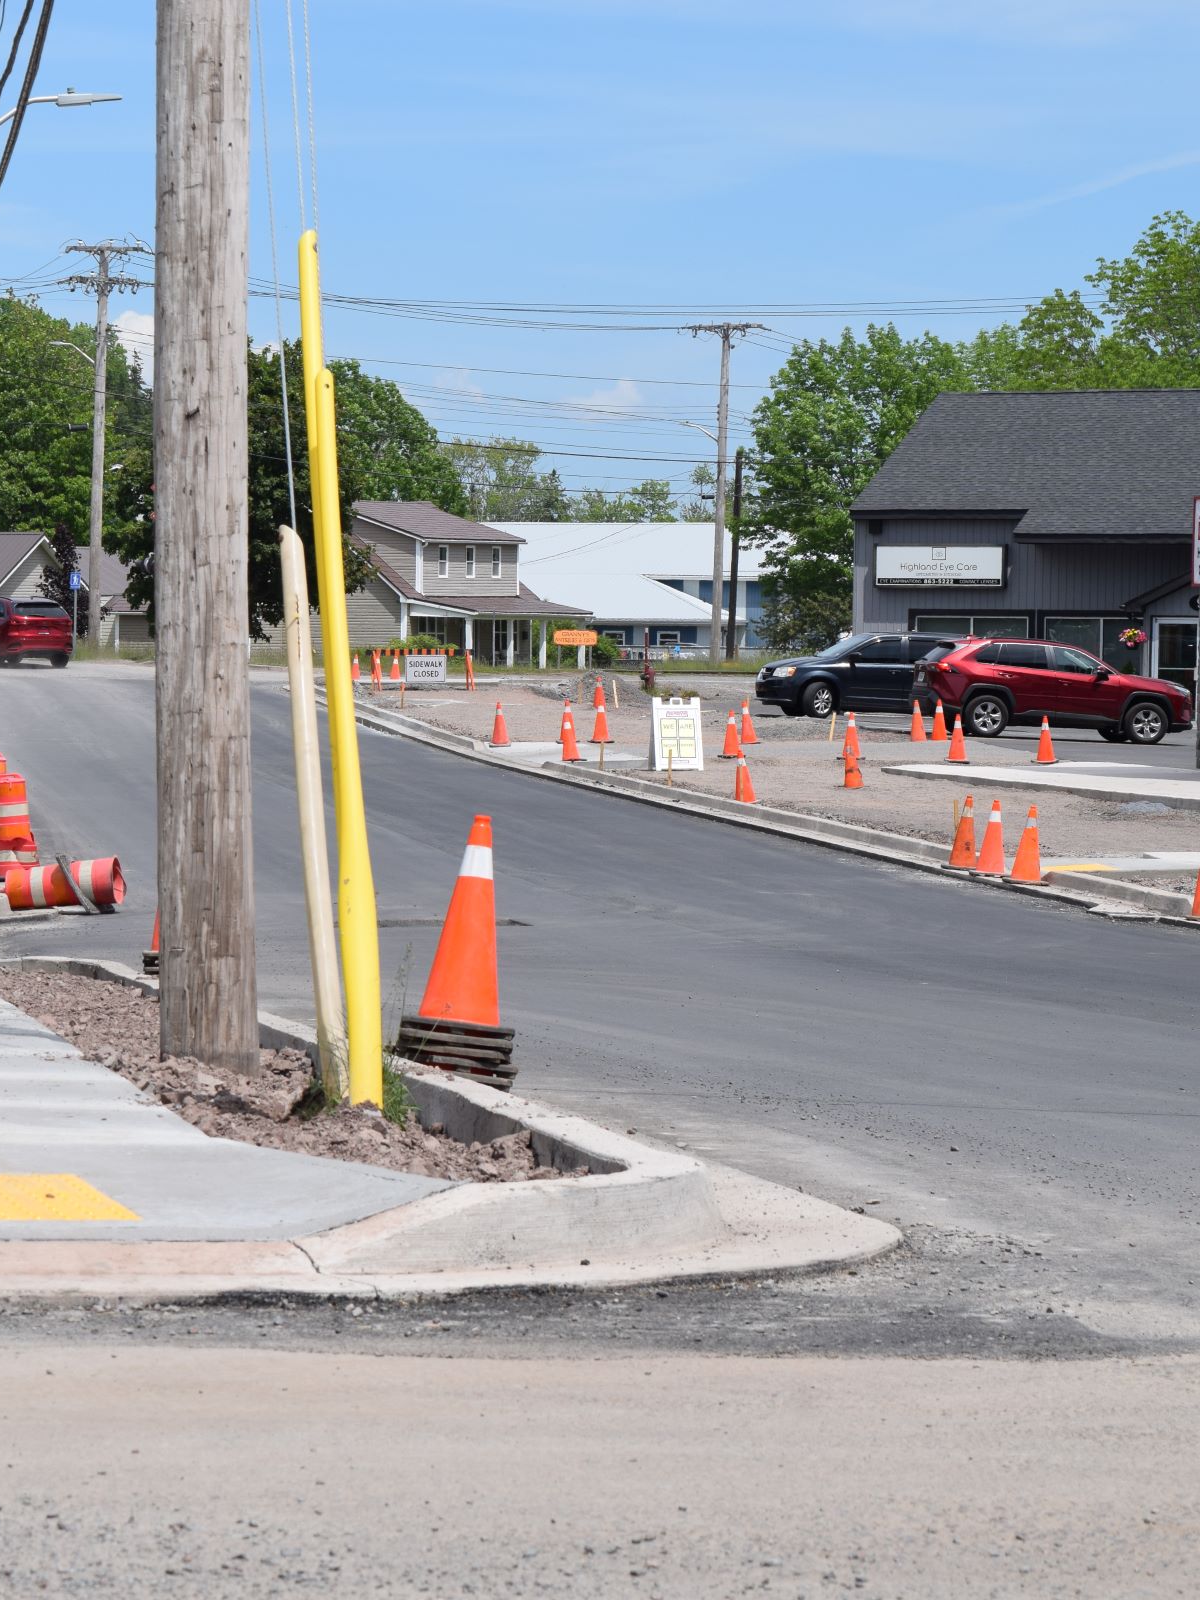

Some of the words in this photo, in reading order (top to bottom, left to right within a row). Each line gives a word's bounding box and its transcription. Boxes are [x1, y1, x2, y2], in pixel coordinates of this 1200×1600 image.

[900, 563, 938, 572] Highland
[939, 563, 955, 572] Eye
[957, 563, 978, 571] Care
